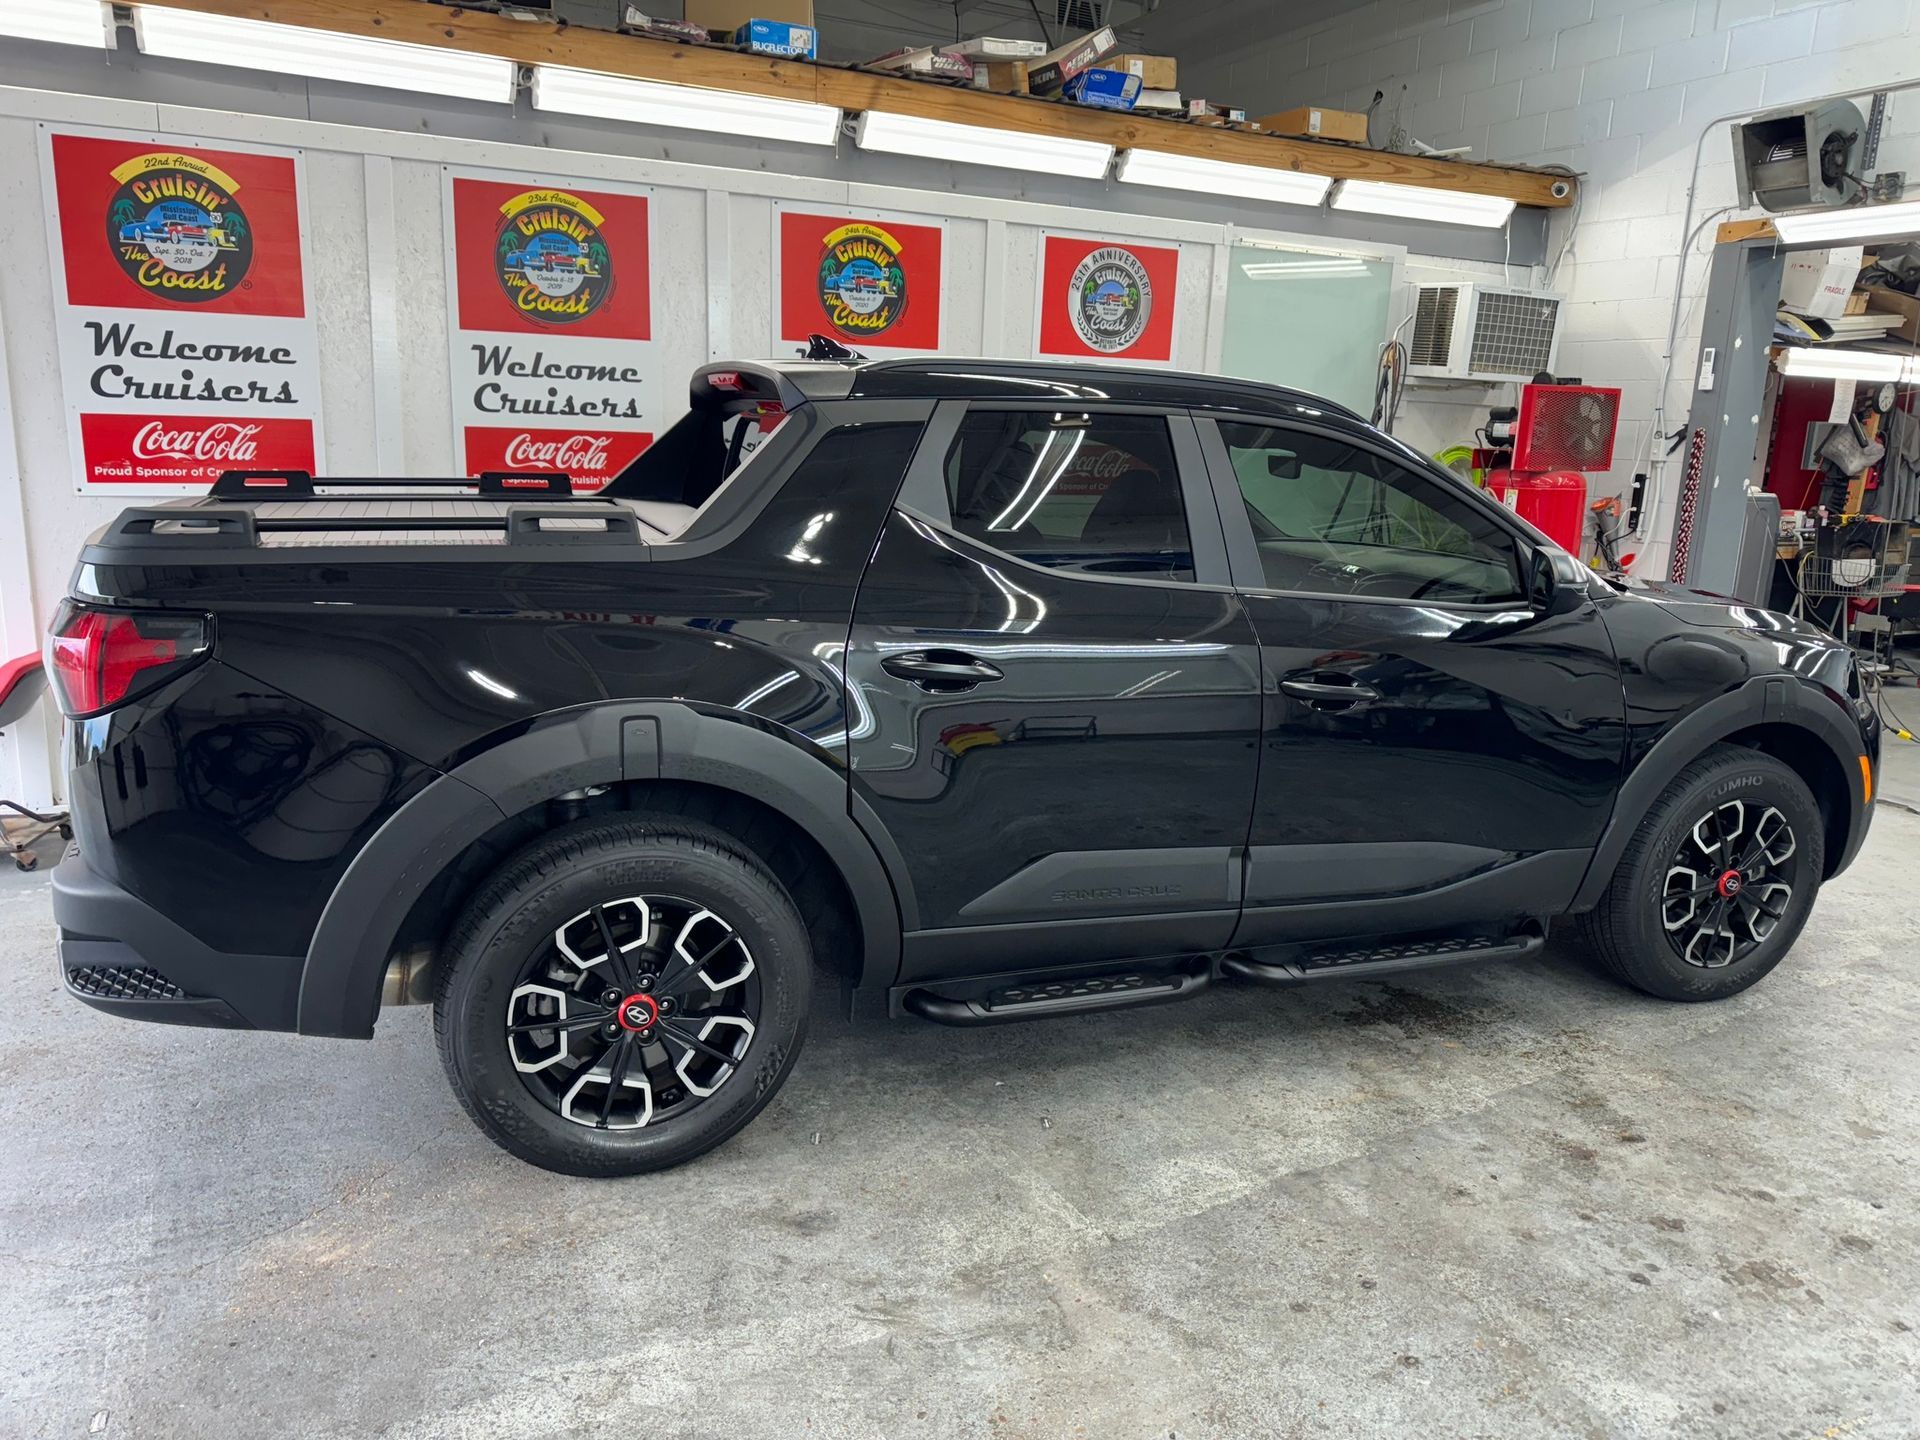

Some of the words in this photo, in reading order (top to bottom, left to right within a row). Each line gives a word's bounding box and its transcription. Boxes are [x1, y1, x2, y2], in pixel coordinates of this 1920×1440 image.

[144, 157, 170, 169] 22nd
[173, 156, 209, 174] Annual
[132, 172, 228, 210] Cruisin'
[178, 213, 199, 223] Coast
[516, 208, 595, 241] Cruisin'
[119, 246, 151, 262] The
[173, 256, 193, 264] 2018
[835, 239, 894, 267] Cruisin'
[138, 258, 227, 291] Coast
[504, 273, 528, 288] The
[1092, 249, 1151, 297] ANNIVERSARY
[517, 284, 590, 314] Coast
[824, 293, 842, 306] The
[833, 305, 889, 329] Coast
[1091, 315, 1127, 330] Coast
[84, 321, 298, 364] Welcome
[471, 344, 643, 383] Welcome
[90, 364, 299, 404] Cruisers
[473, 382, 643, 418] Cruisers
[132, 421, 264, 461] Coca-Cola
[505, 433, 613, 470] Coca-Cola
[95, 465, 133, 477] Proud
[136, 466, 187, 480] Sponsor
[190, 467, 204, 478] of
[1706, 775, 1764, 800] KUMHO
[1052, 888, 1122, 901] SANTA
[1127, 884, 1183, 897] CRUZ
